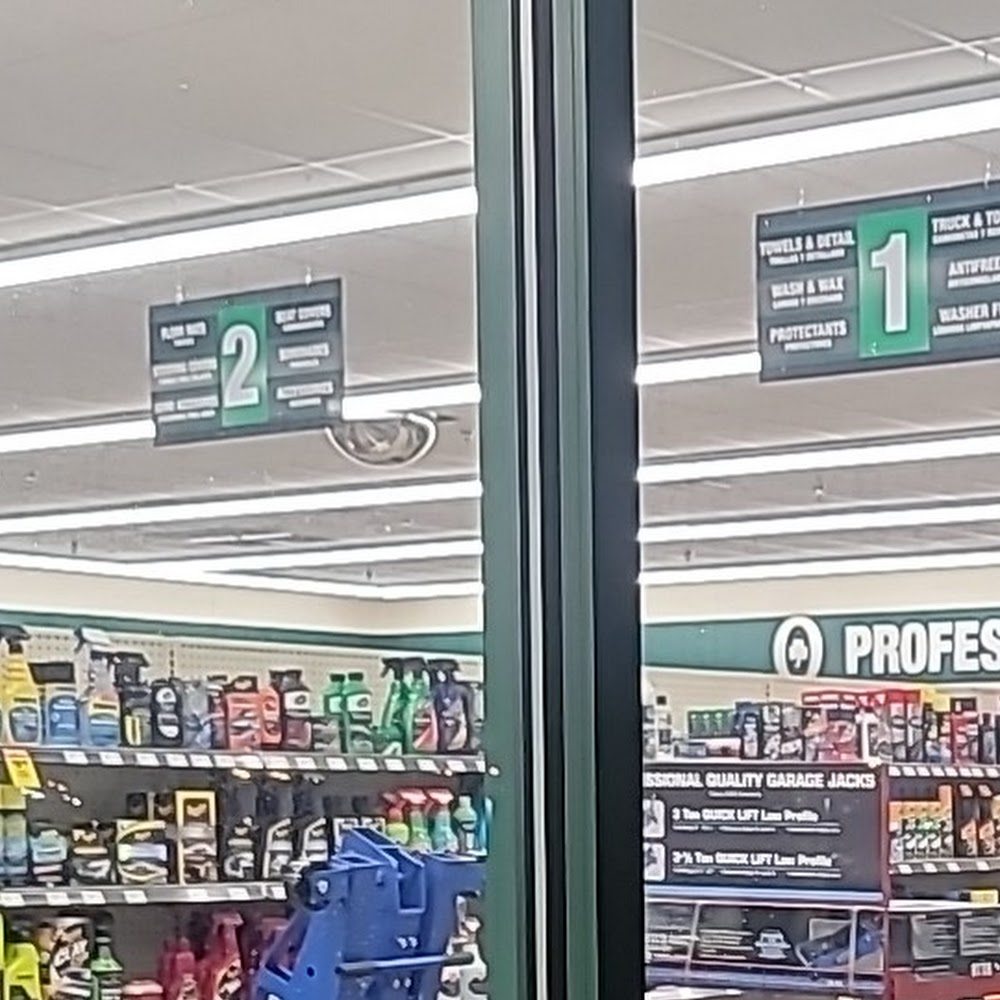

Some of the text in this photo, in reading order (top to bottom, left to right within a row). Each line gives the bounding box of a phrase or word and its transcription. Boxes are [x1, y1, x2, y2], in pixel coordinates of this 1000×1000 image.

[818, 276, 844, 293] WAX
[870, 232, 908, 333] 1
[939, 302, 990, 323] WASHER
[770, 319, 847, 344] PROTECTANTS
[222, 324, 260, 409] 2
[705, 771, 763, 788] QUALITY
[766, 772, 825, 788] GARAGE
[827, 772, 876, 789] JACKS
